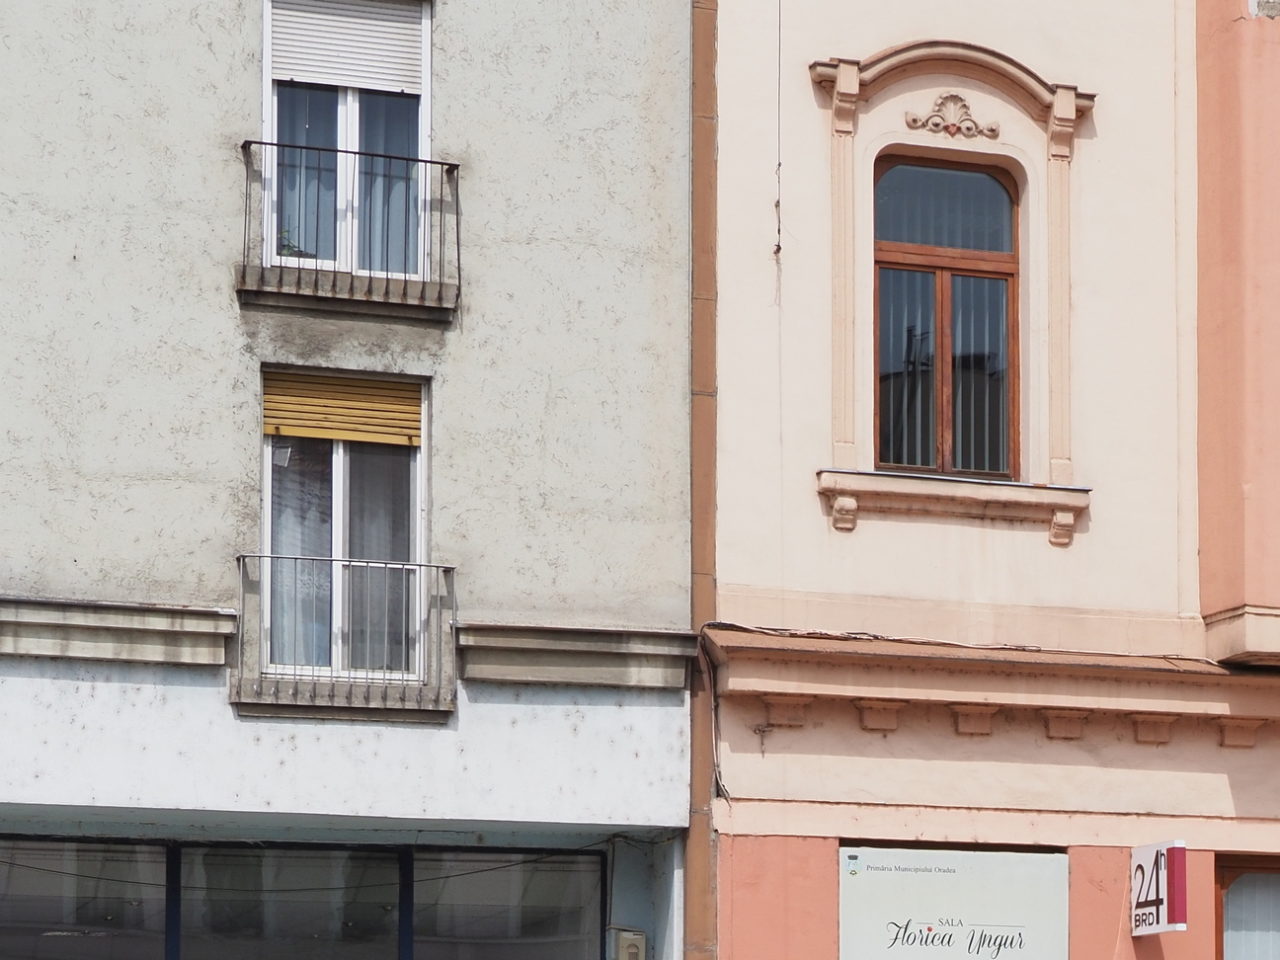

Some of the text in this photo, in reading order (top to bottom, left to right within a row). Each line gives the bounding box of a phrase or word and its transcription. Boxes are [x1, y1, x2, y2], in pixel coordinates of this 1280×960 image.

[934, 866, 956, 874] Oradea
[1134, 849, 1166, 925] 24h
[938, 918, 964, 927] SALA
[1134, 912, 1155, 929] BRD
[886, 918, 1026, 960] Florica Ungur
